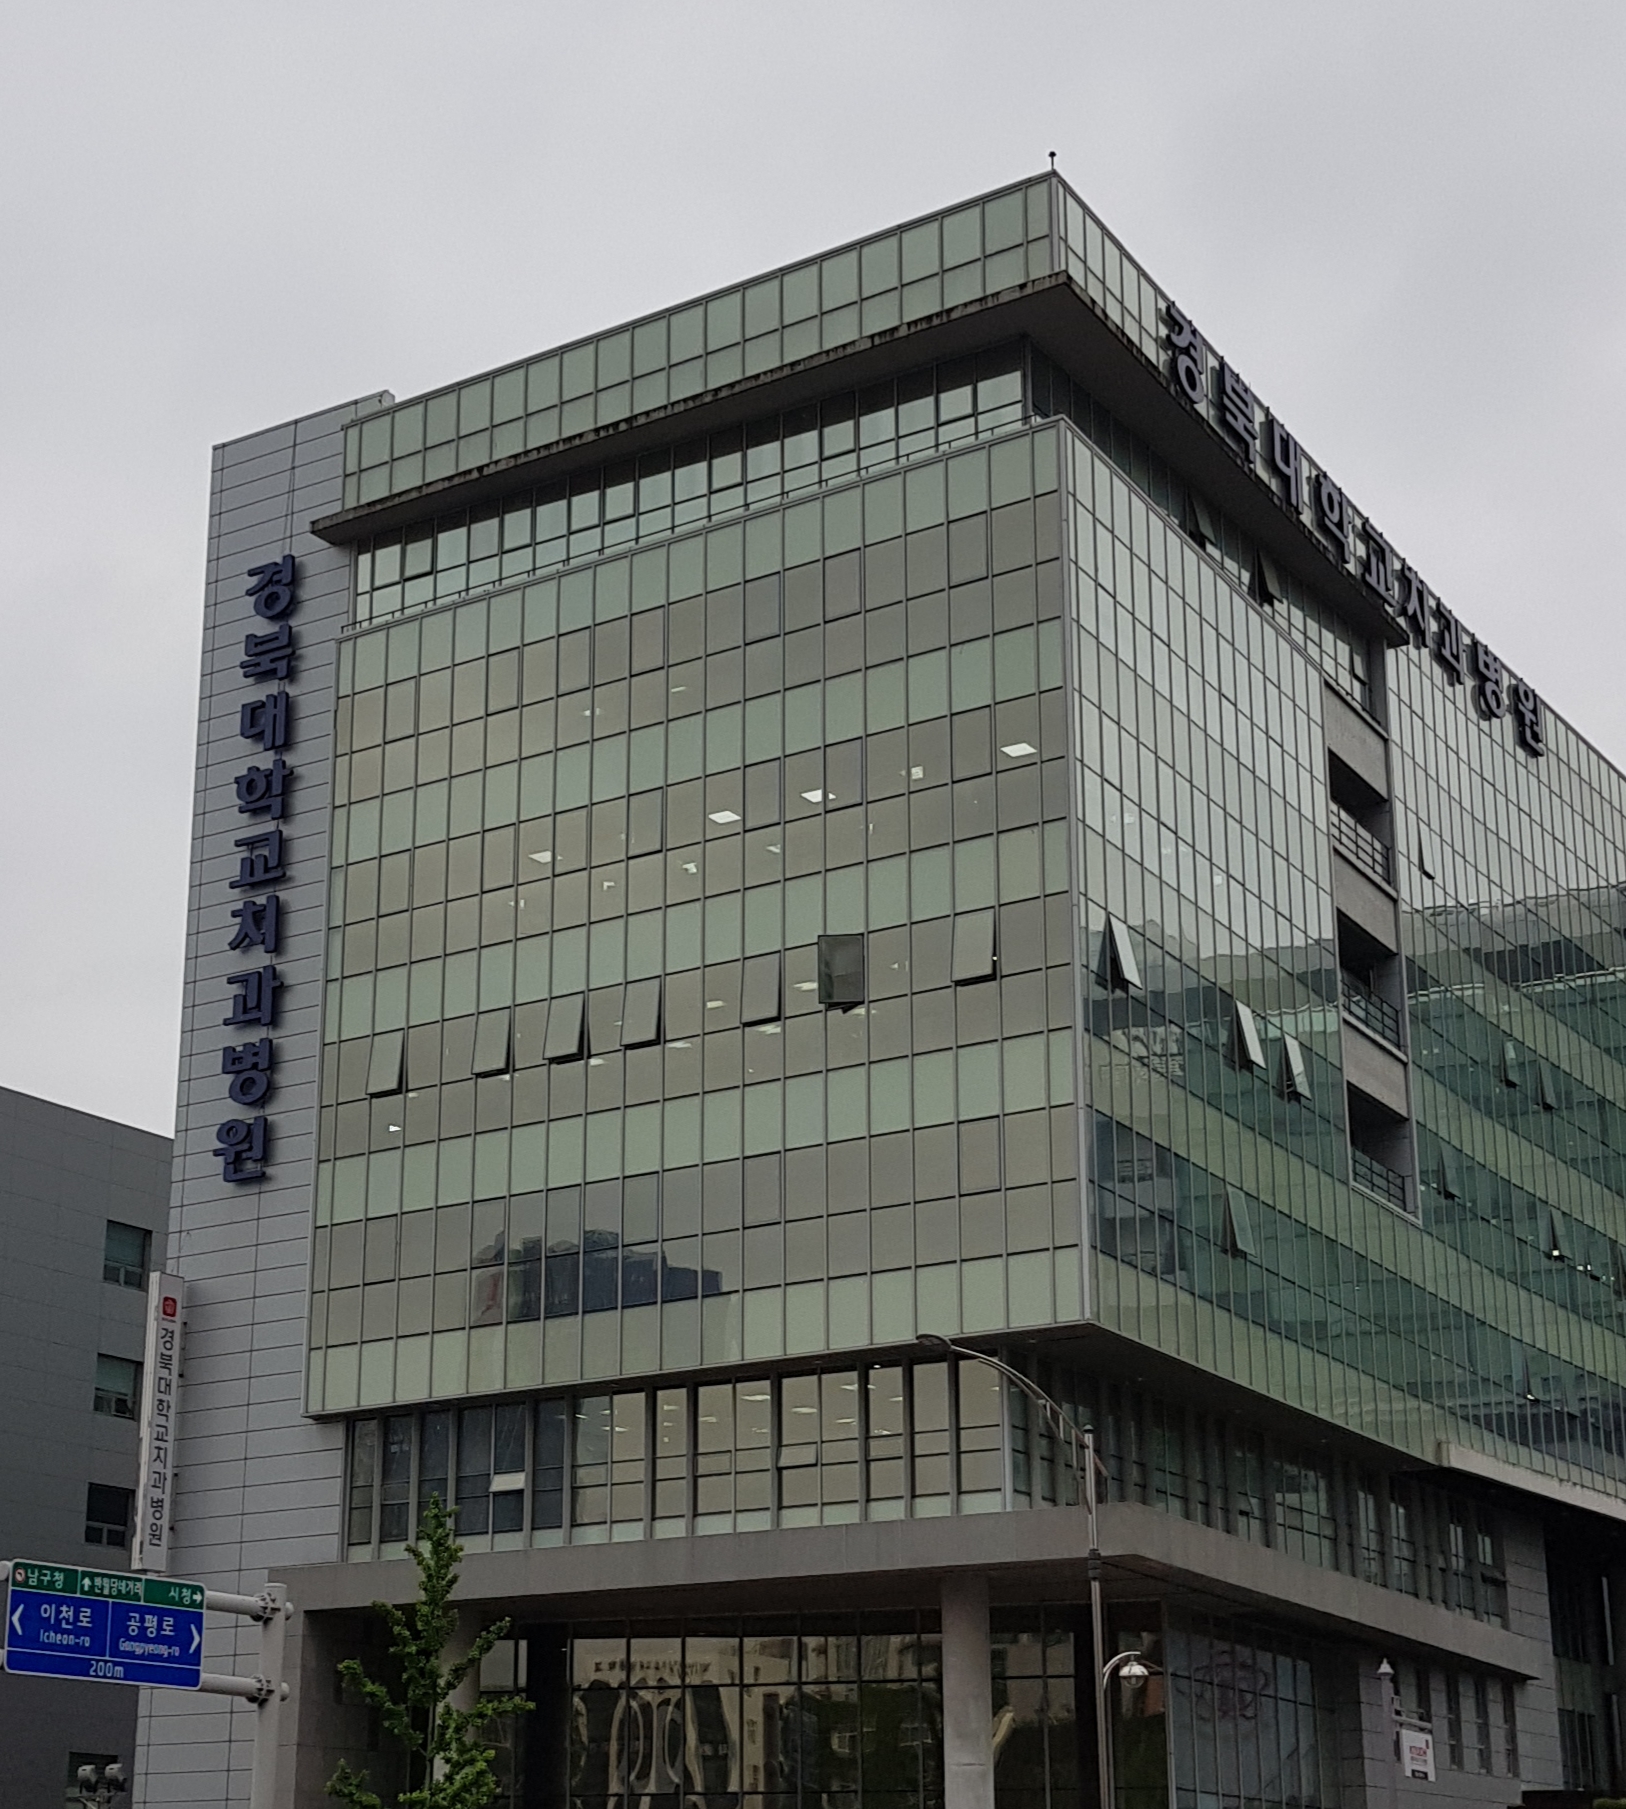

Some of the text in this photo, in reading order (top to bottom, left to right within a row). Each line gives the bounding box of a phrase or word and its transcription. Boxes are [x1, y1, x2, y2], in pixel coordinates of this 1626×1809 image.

[1166, 302, 1544, 756] 경북대학교치과병원
[213, 554, 297, 1184] 경북대학교치과병원
[148, 1327, 175, 1547] 경북대학교치과병원
[27, 1569, 65, 1589] 남구청
[94, 1576, 143, 1597] 반월당네거리
[168, 1587, 192, 1604] 시청
[41, 1604, 92, 1628] 이천로
[127, 1613, 175, 1637] 공평로
[40, 1629, 90, 1647] Icheon-ro
[119, 1638, 180, 1657] Gongpyeong-ro
[90, 1661, 124, 1678] 200m
